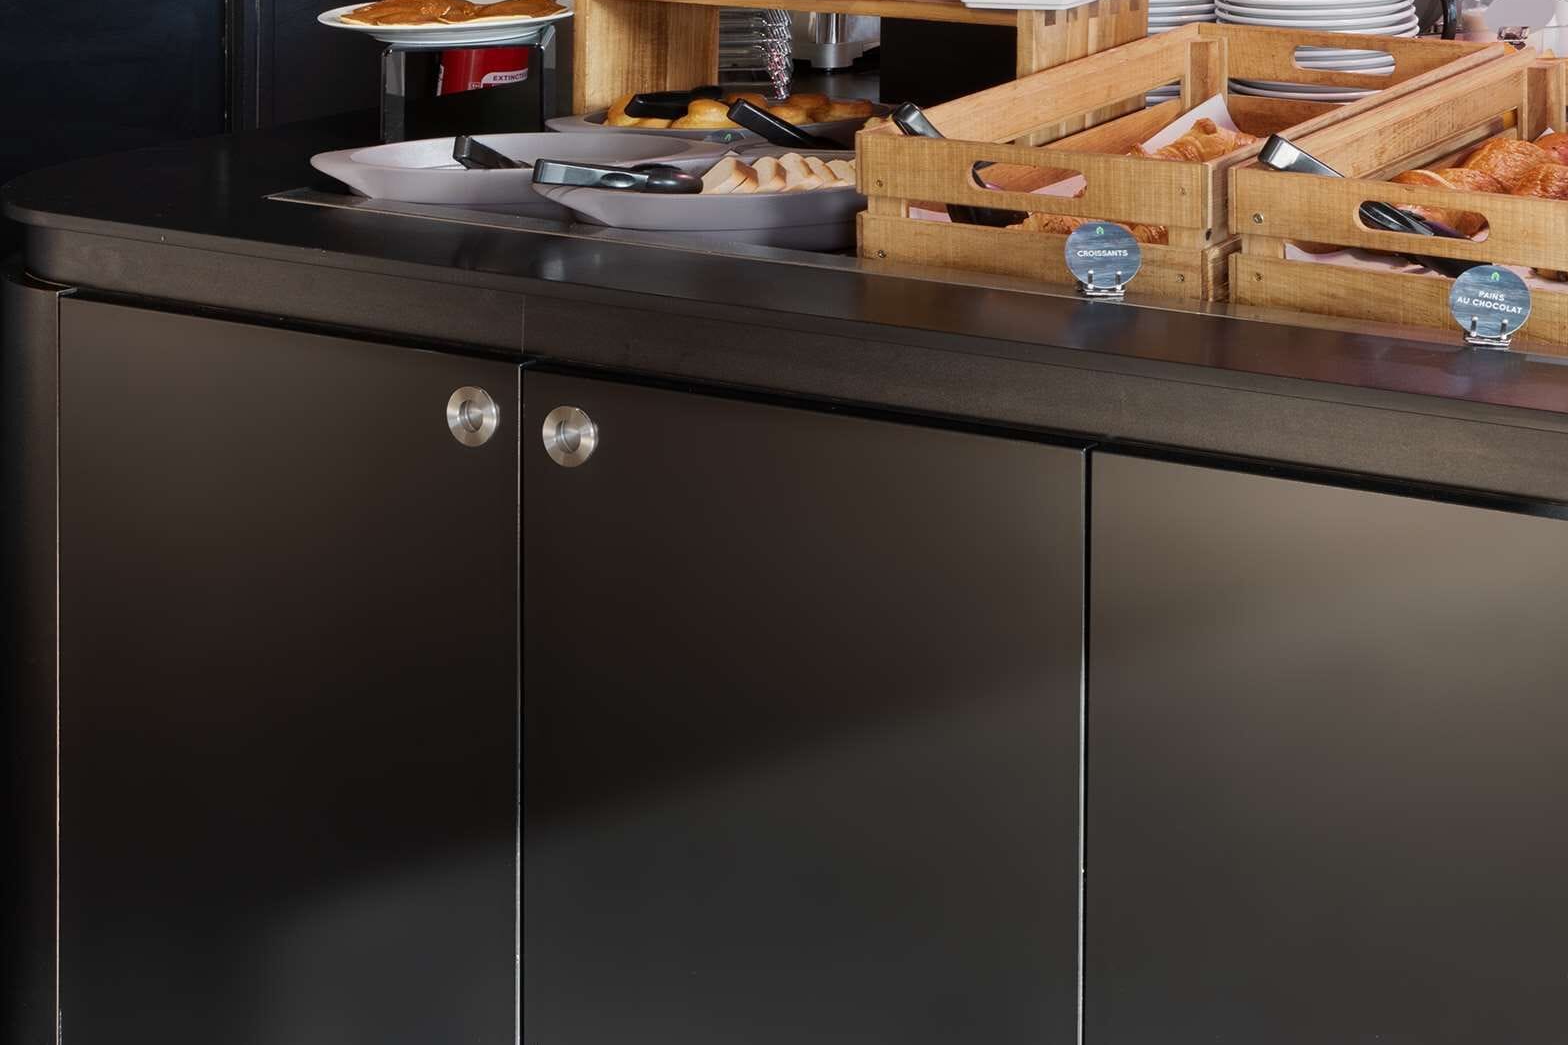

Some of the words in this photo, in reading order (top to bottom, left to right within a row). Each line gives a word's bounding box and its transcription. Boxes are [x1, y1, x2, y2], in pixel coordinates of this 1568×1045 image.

[1076, 249, 1129, 257] CROISSANTS
[1478, 290, 1505, 302] PAINS
[1457, 296, 1470, 304] AU
[1472, 298, 1523, 315] CHOCOLAT
